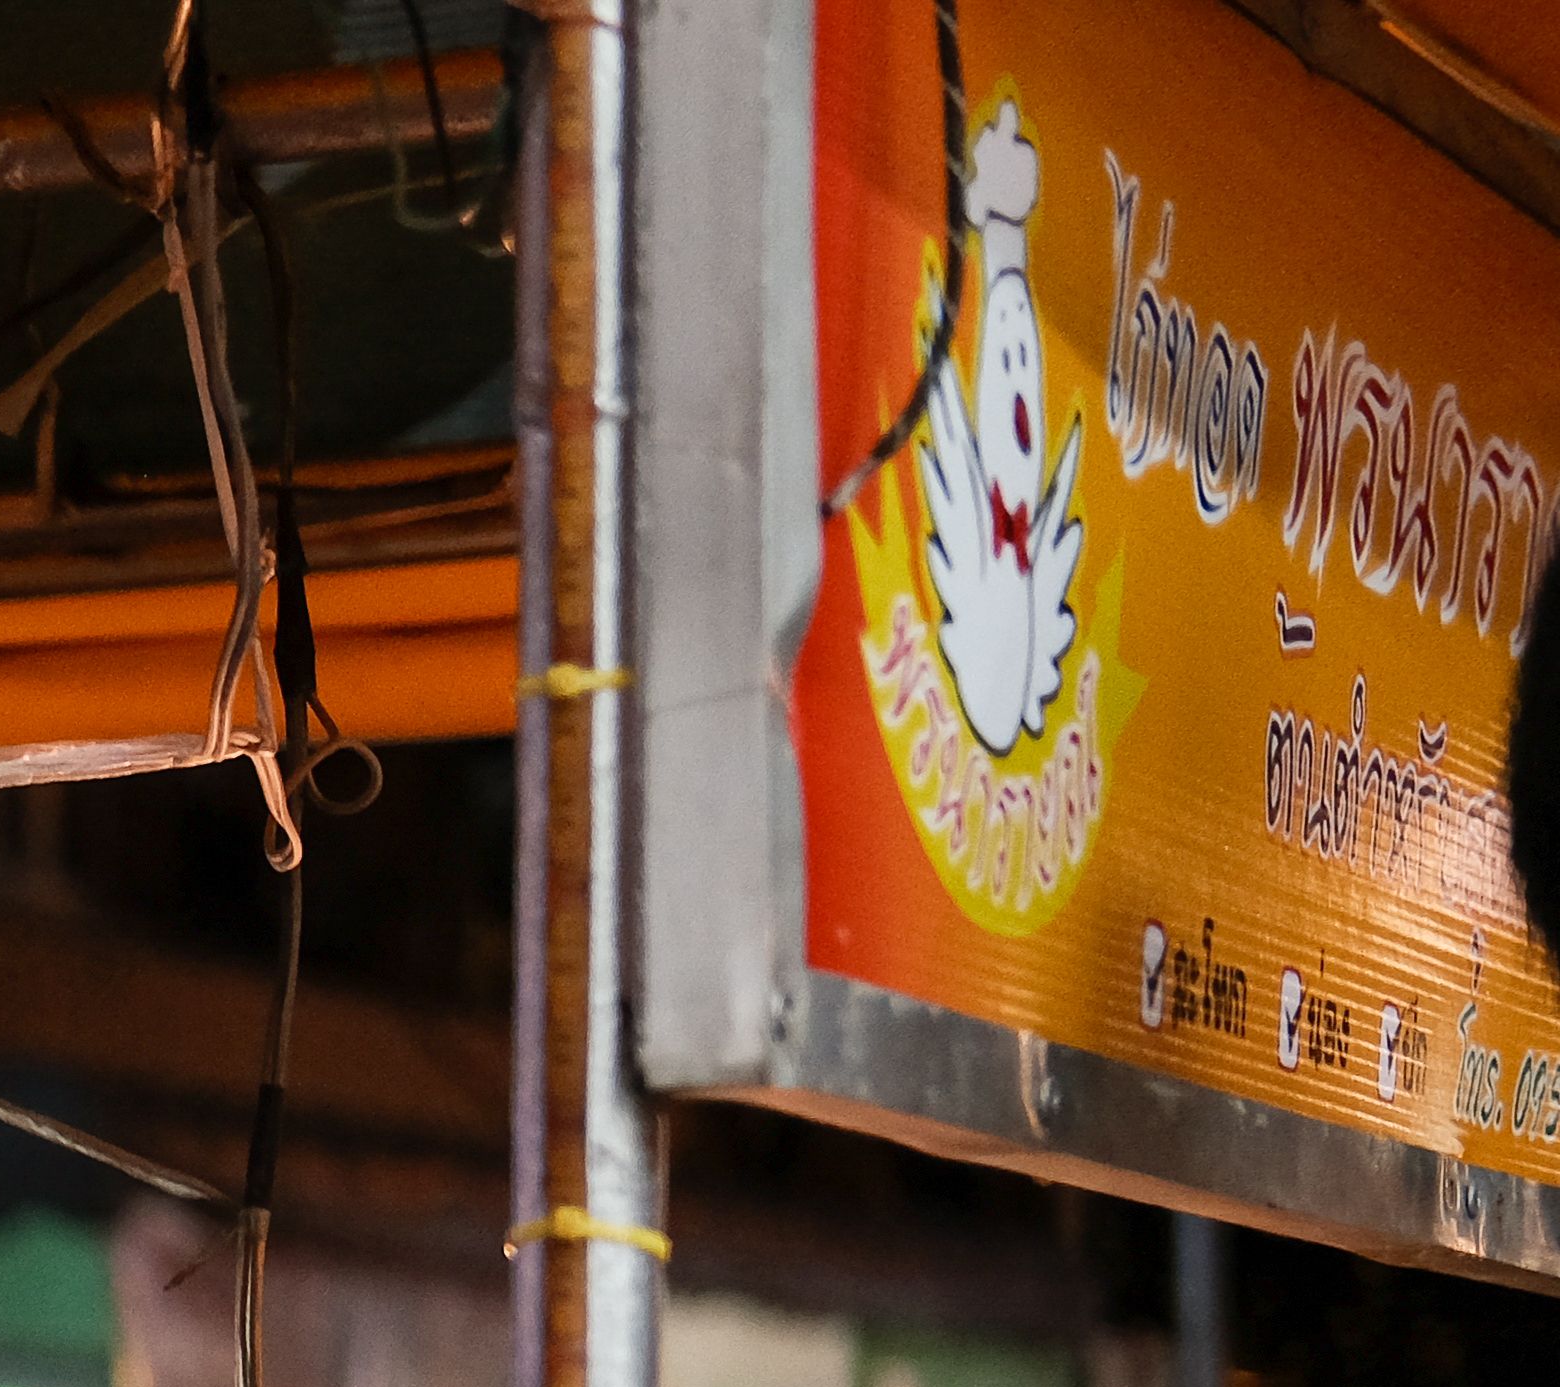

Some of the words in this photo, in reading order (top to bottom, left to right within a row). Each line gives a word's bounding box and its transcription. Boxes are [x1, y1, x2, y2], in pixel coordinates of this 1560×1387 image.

[1106, 147, 1268, 524] ไก่ทอด
[1282, 325, 1560, 656] พรนารา
[1454, 1001, 1505, 1130] โทร.
